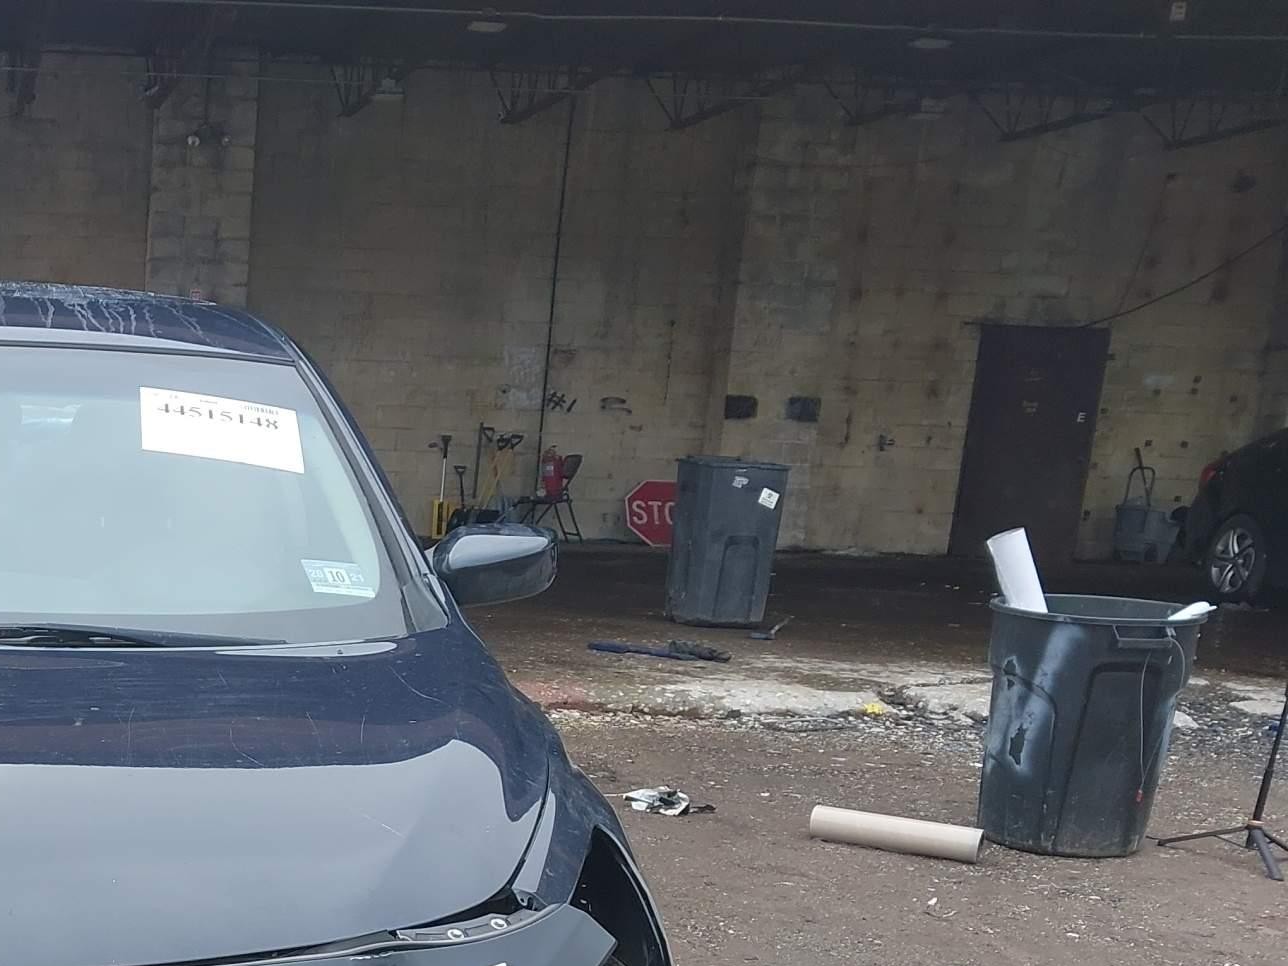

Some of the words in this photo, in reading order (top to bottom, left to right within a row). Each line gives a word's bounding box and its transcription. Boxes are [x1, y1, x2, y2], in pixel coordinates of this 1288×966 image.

[157, 402, 279, 431] 44515148
[631, 499, 676, 525] STO
[328, 570, 346, 583] 10
